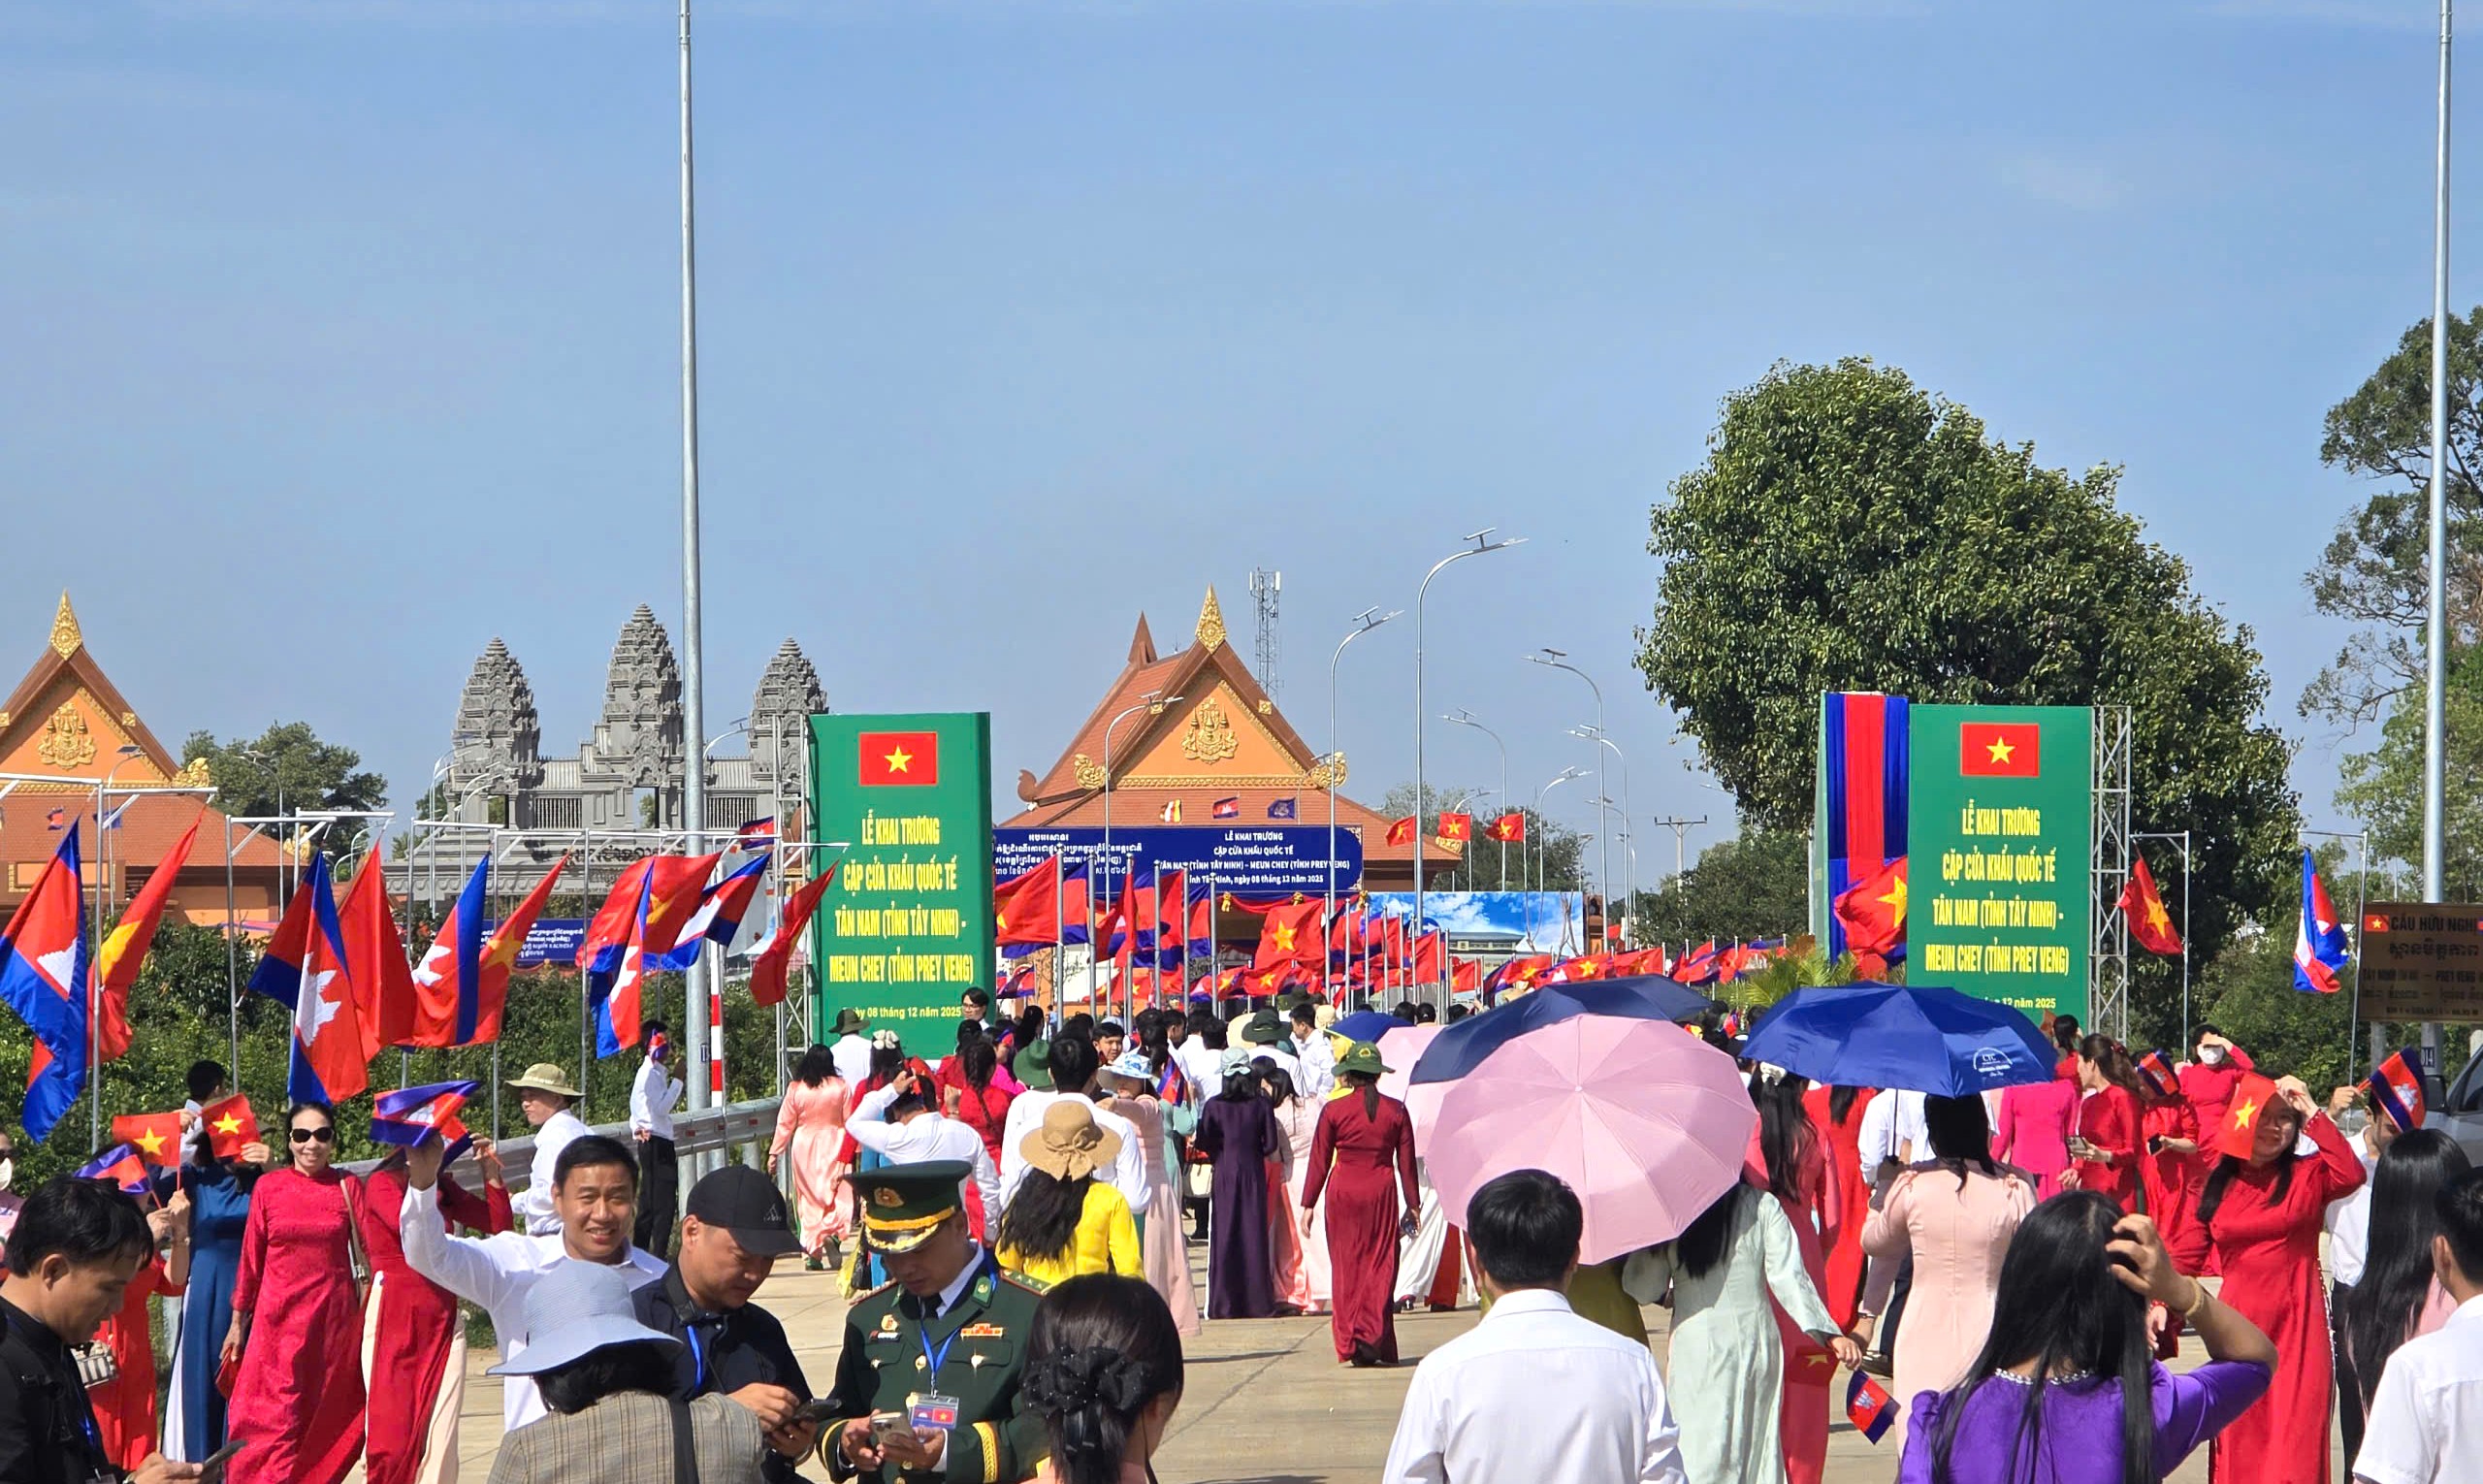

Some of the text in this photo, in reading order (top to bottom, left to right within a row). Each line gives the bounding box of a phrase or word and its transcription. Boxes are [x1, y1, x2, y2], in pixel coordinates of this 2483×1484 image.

[861, 809, 940, 845] LỄ KHAI TRƯƠNG
[1962, 798, 2041, 836] LỄ KHAI TRƯƠNG
[1213, 844, 1294, 857] CẶP CỬA KHẨU QUỐC TẾ
[1235, 832, 1252, 841] KHAI
[1253, 831, 1283, 841] TRƯƠNG
[843, 854, 957, 896] CẶP CỬA KHẨU QUỐC TẾ
[1173, 861, 1187, 870] NA
[1209, 859, 1223, 870] TÂY
[1223, 861, 1243, 871] NINH)
[1271, 860, 1289, 869] CHEY
[1310, 860, 1328, 869] PREY
[1234, 874, 1250, 885] ngày
[1251, 875, 1260, 884] 08
[1261, 874, 1281, 886] tháng
[1282, 875, 1290, 884] 12
[1291, 874, 1306, 884] năm
[1307, 875, 1323, 884] 2025
[1943, 843, 2056, 887] CẶP CỬA KHẨU QUỐC TẾ
[835, 904, 855, 937] TÂN
[856, 909, 881, 937] NAM
[882, 900, 909, 939] (TỈNH
[910, 903, 929, 936] TÂY
[930, 909, 959, 939] NINH)
[1932, 892, 1953, 926] TÂN
[1954, 899, 1978, 926] NAM
[1981, 890, 2007, 929] (TỈNH
[2008, 894, 2027, 927] TÂY
[2028, 900, 2056, 930] NINH)
[829, 946, 974, 985] MEUN CHEY (TỈNH PREY VENG)
[1925, 936, 2069, 976] MEUN CHEY (TỈNH PREY VENG)
[867, 1008, 878, 1017] 08
[880, 1007, 905, 1019] tháng
[908, 1008, 918, 1017] 12
[919, 1007, 939, 1017] năm
[940, 1008, 962, 1017] 2025
[2014, 997, 2033, 1009] năm
[2035, 997, 2056, 1009] 2025
